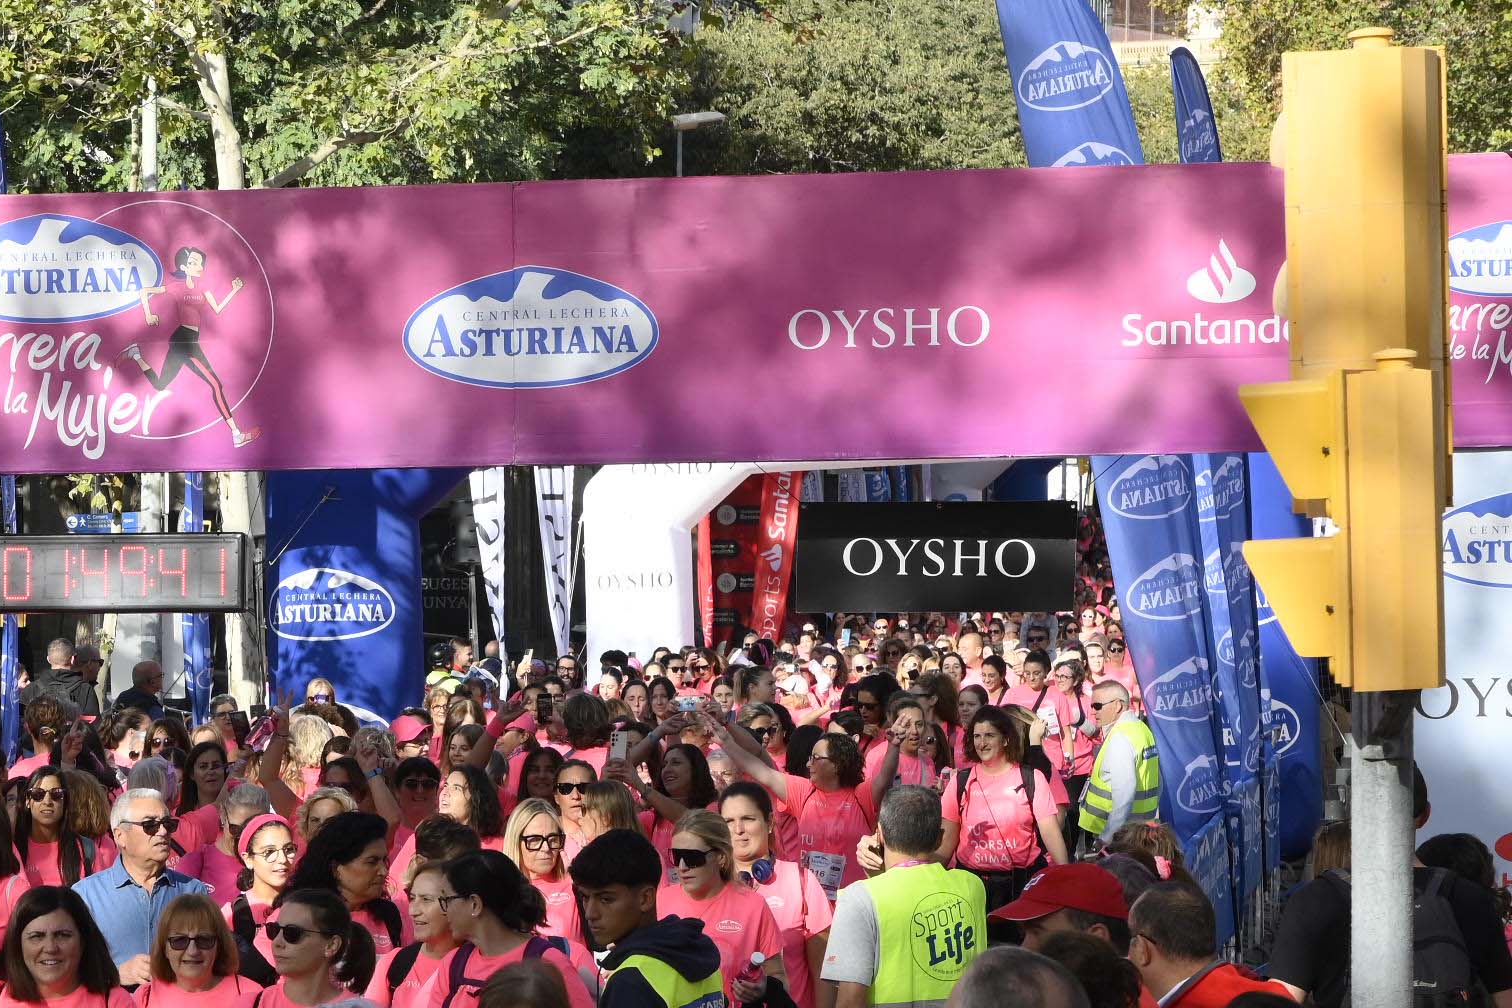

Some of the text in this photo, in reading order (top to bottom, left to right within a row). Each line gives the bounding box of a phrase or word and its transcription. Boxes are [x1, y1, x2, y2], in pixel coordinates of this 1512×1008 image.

[65, 250, 137, 262] LECHERA
[462, 306, 630, 322] CENTRAL LECHERA
[789, 305, 990, 350] OYSHO
[423, 314, 639, 358] ASTURIANA
[1471, 333, 1490, 361] la
[3, 377, 28, 415] la
[24, 366, 173, 460] Mujer
[3, 546, 227, 600] 01:49:41
[842, 537, 1036, 578] OYSHO
[272, 600, 386, 626] ASTURIANA
[285, 593, 381, 602] CENTRAL LECHERA
[913, 899, 964, 938] Sport
[926, 921, 975, 966] Life
